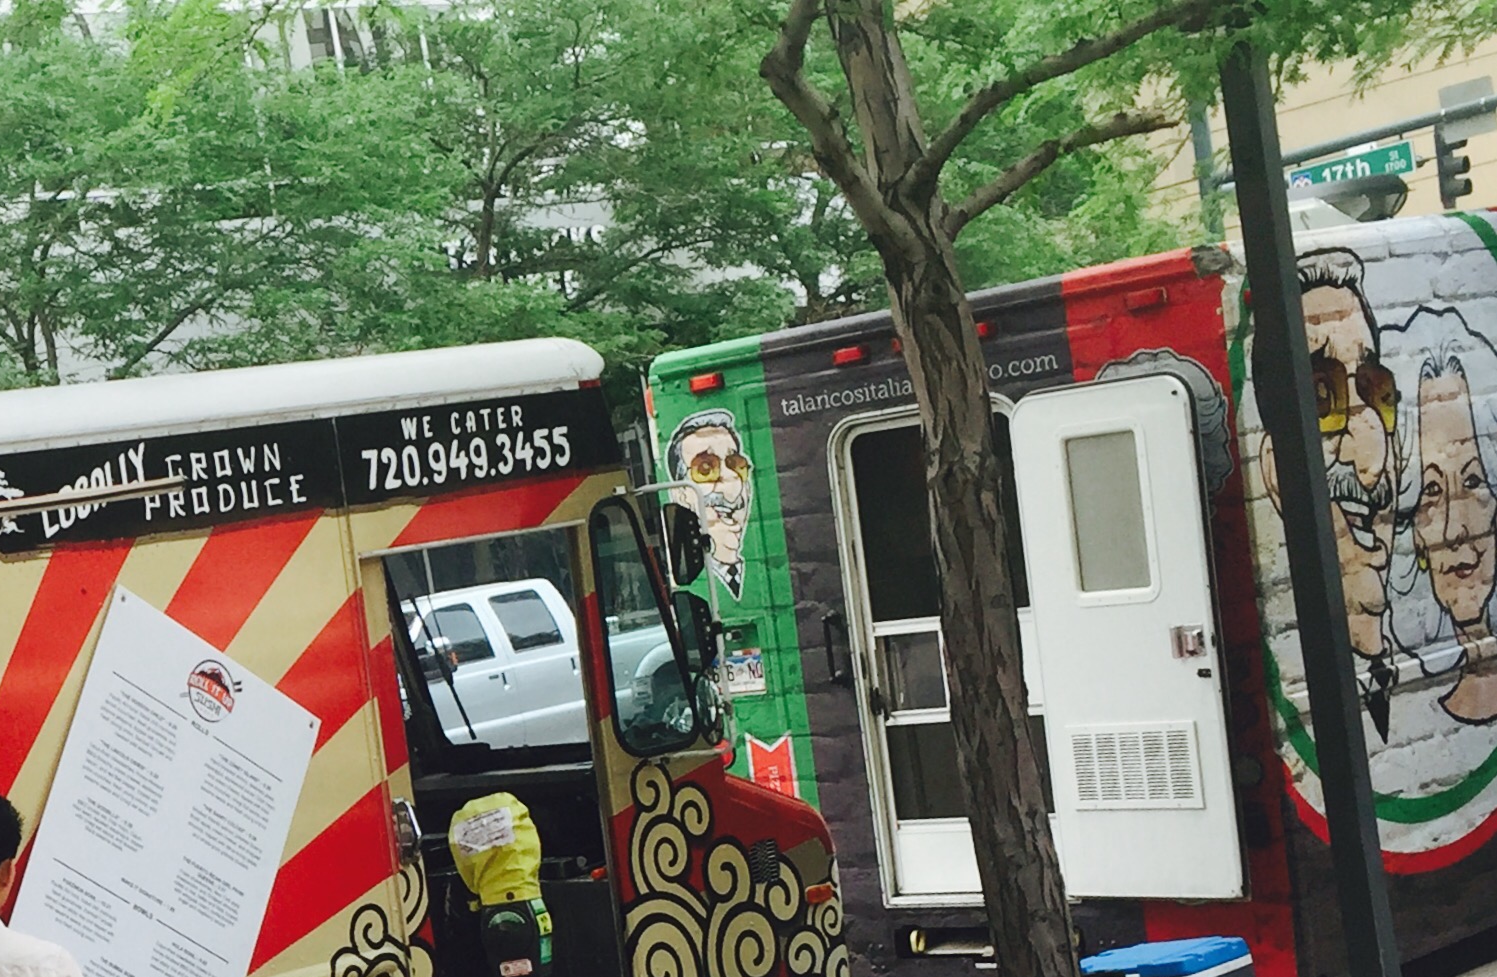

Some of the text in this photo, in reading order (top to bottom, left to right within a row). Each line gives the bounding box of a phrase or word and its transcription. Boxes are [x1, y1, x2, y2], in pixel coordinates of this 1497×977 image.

[1322, 158, 1371, 182] 17th
[401, 405, 523, 441] WE CATER
[165, 442, 282, 481] GROWN
[361, 426, 571, 491] 720.949.3455
[144, 474, 307, 521] PRODUCE
